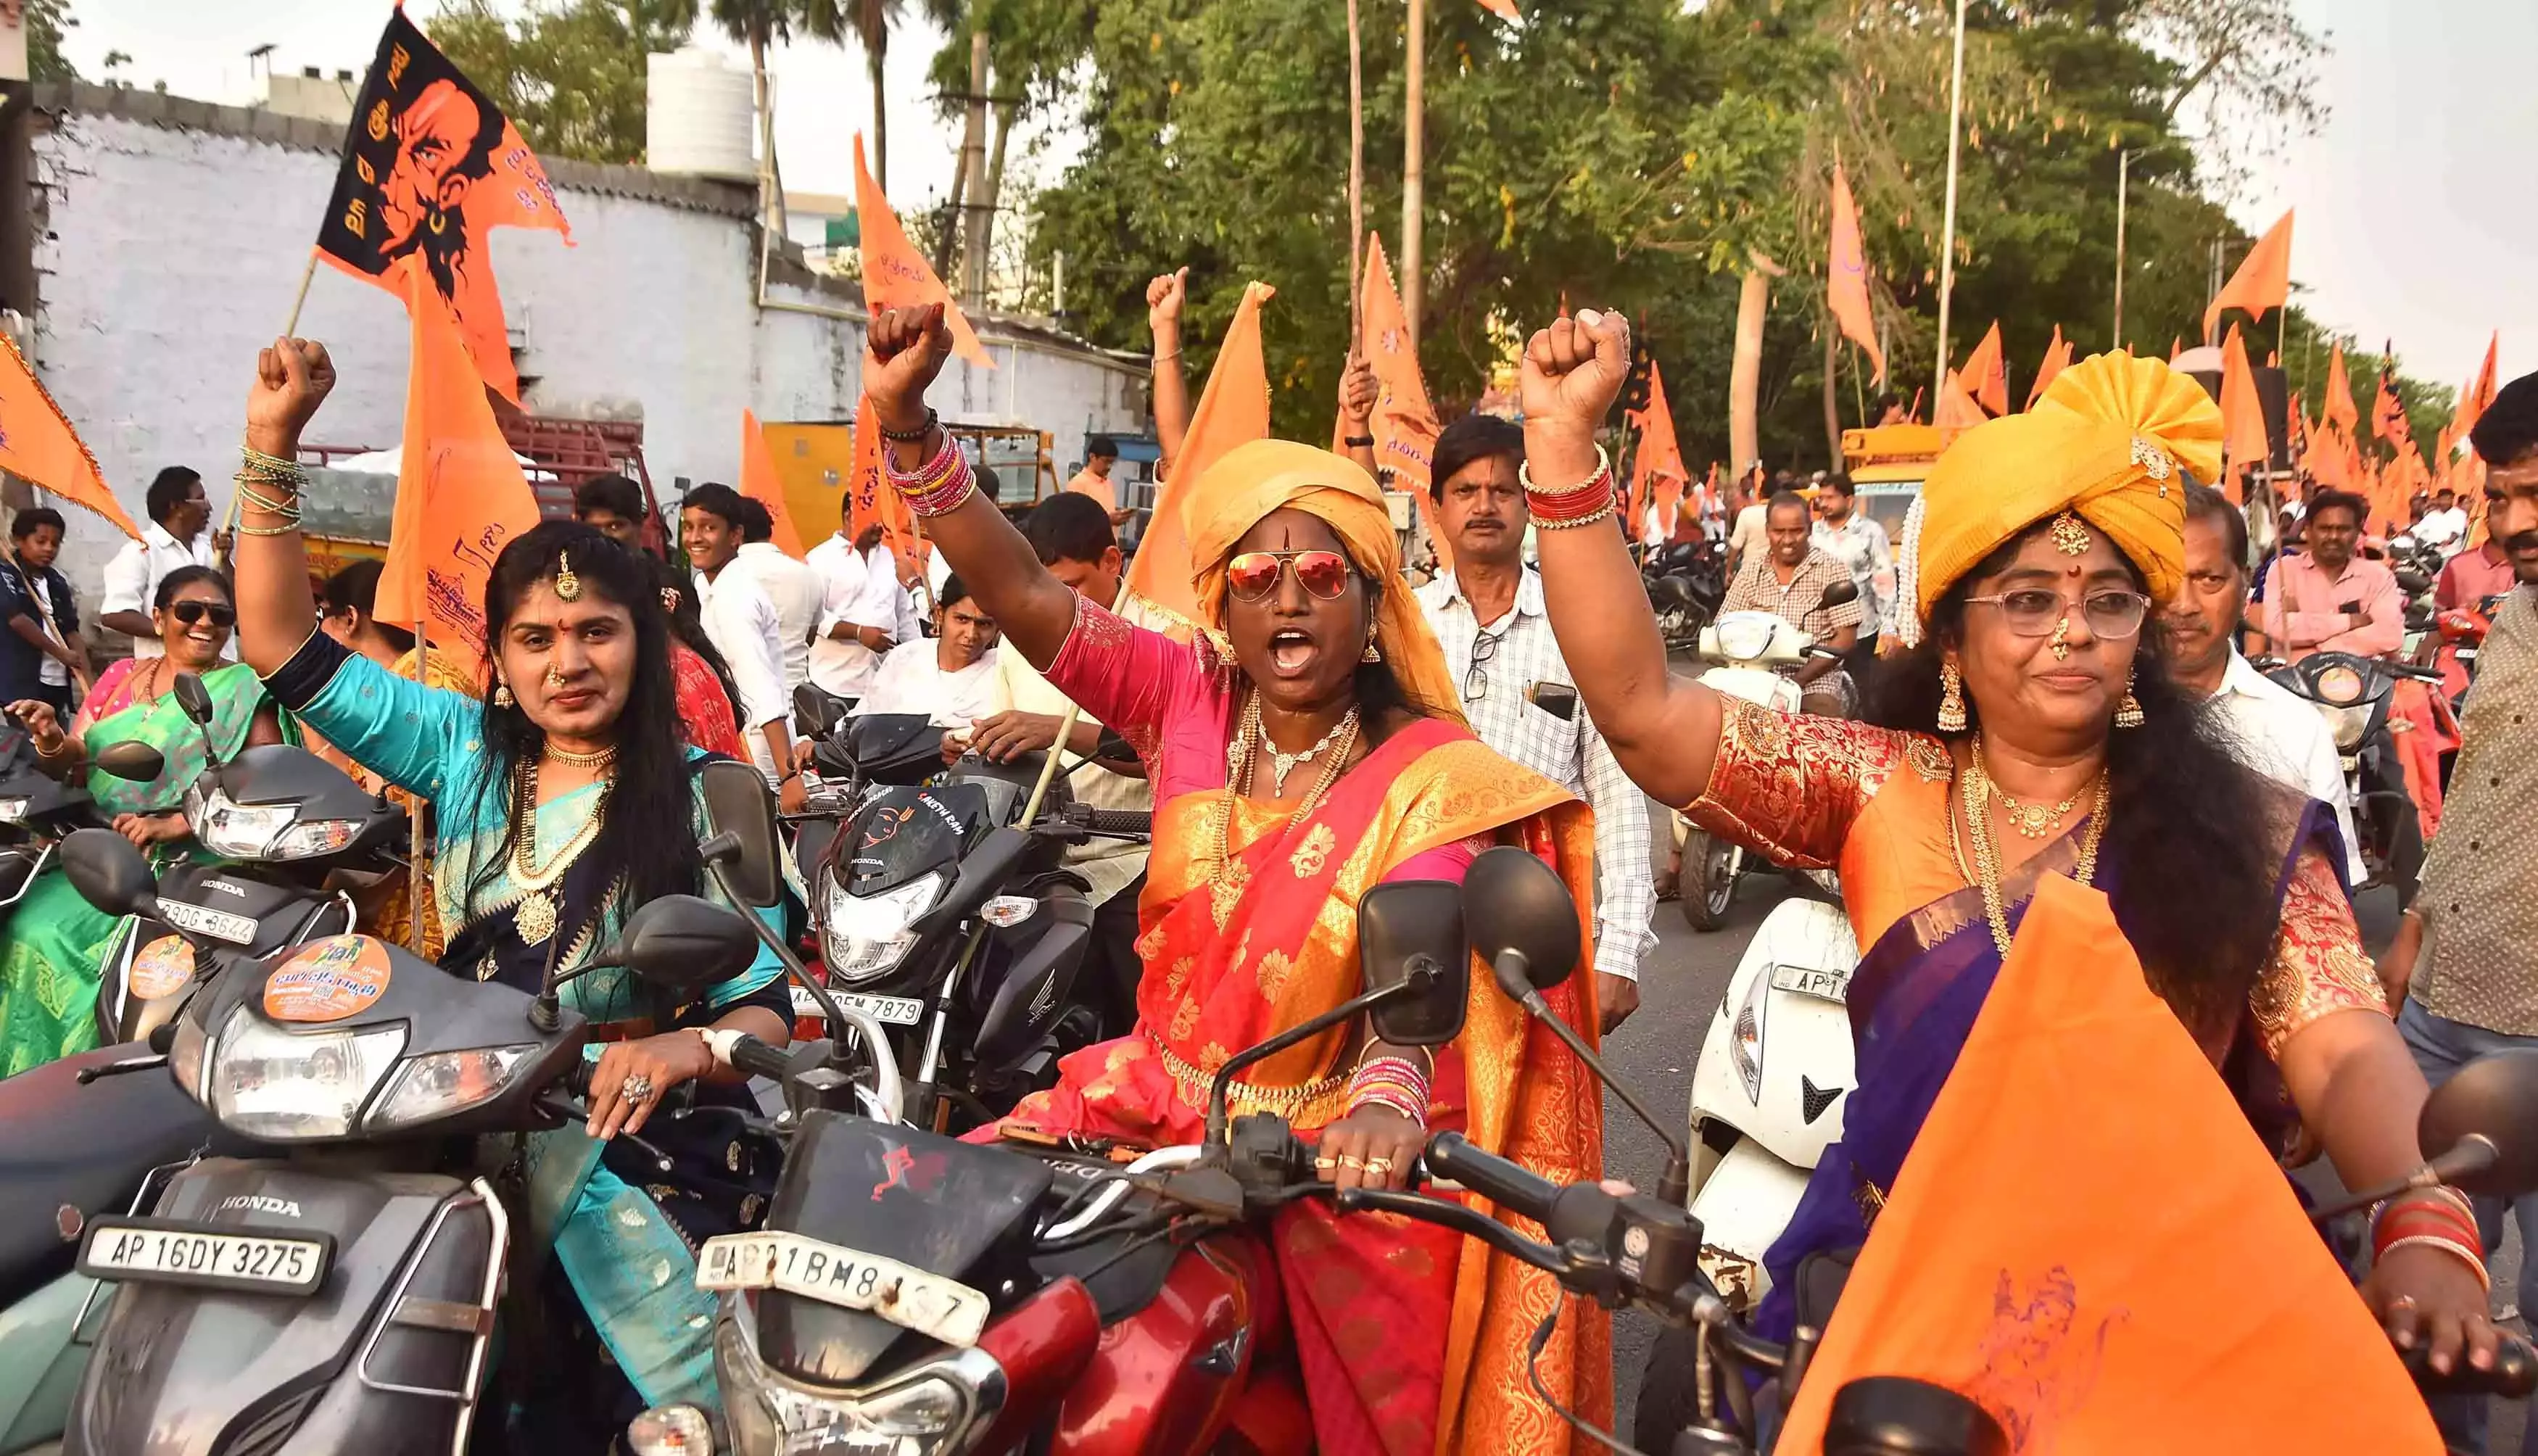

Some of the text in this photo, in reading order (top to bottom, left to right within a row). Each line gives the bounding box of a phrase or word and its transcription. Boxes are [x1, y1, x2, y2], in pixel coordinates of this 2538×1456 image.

[945, 813, 965, 835] RAM
[200, 880, 246, 898] HONDA
[1797, 972, 1825, 991] AP
[872, 999, 917, 1019] 7879
[220, 1196, 302, 1218] HONDA
[111, 1233, 308, 1279] AP 16DY 3275
